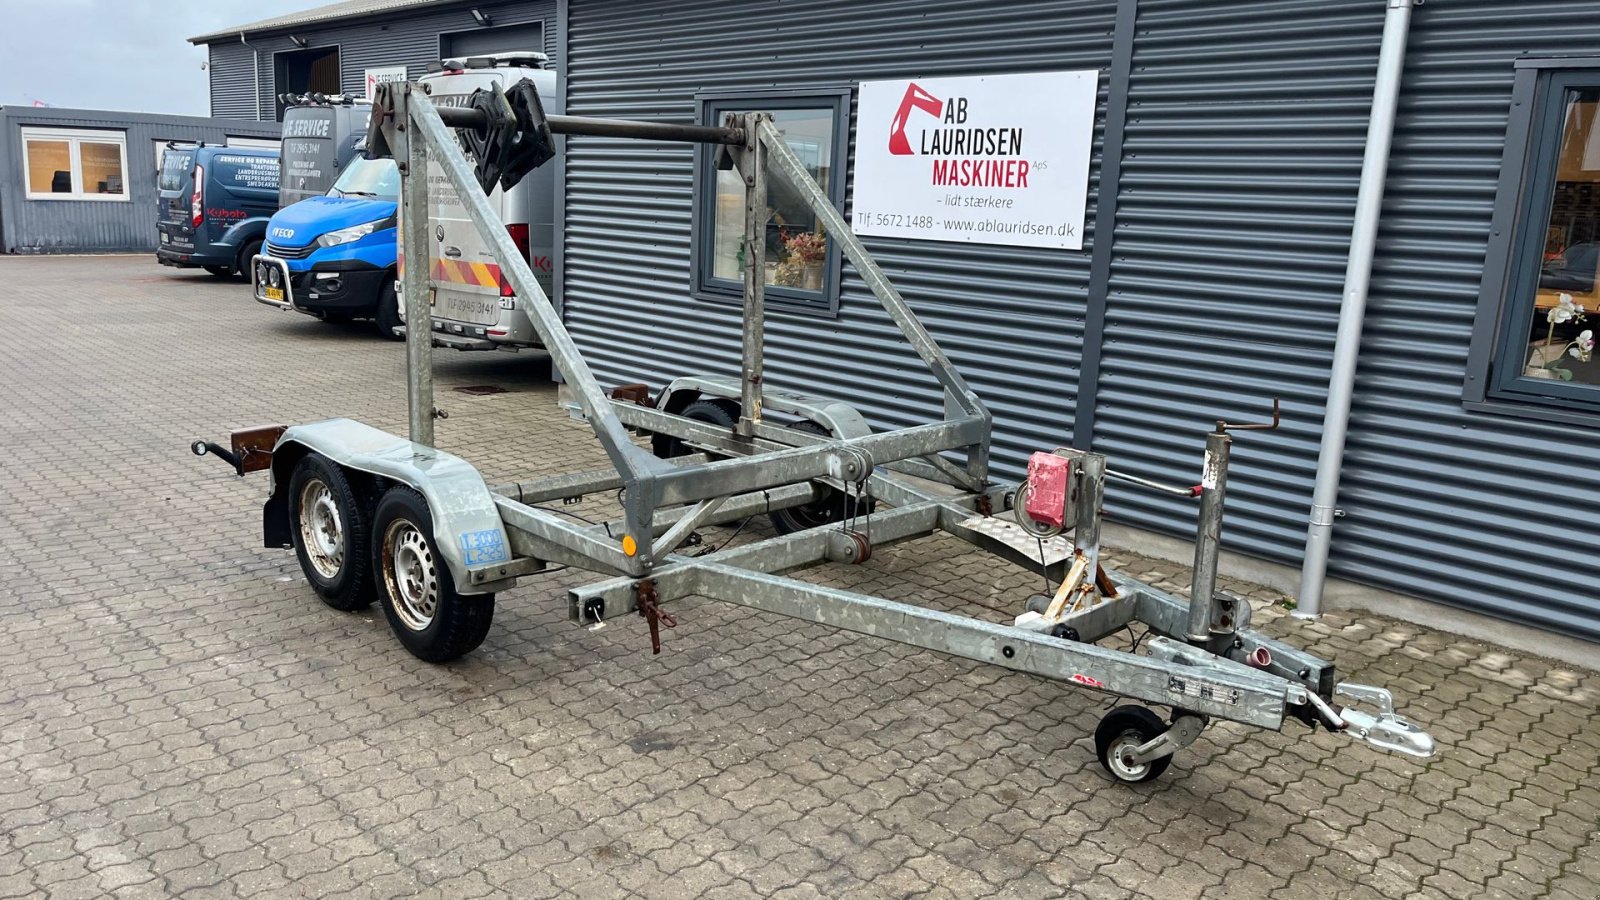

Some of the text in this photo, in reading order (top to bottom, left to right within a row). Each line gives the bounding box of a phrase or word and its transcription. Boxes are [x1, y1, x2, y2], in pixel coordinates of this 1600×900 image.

[944, 97, 968, 124] AB
[293, 119, 330, 136] SERVICE
[921, 128, 1022, 155] LAURIDSEN
[220, 156, 245, 164] SERVICE
[933, 160, 1048, 188] MASKINER ApS
[945, 194, 962, 207] lidt
[964, 196, 1014, 209] stærkere
[207, 208, 248, 218] Kubota
[858, 212, 874, 228] Tlf.
[877, 213, 903, 227] 5672
[906, 215, 933, 229] 1488
[944, 218, 1075, 237] www.ablauridsen.dk
[272, 227, 295, 239] IVECO
[458, 299, 476, 312] 2945
[477, 302, 494, 315] 3141
